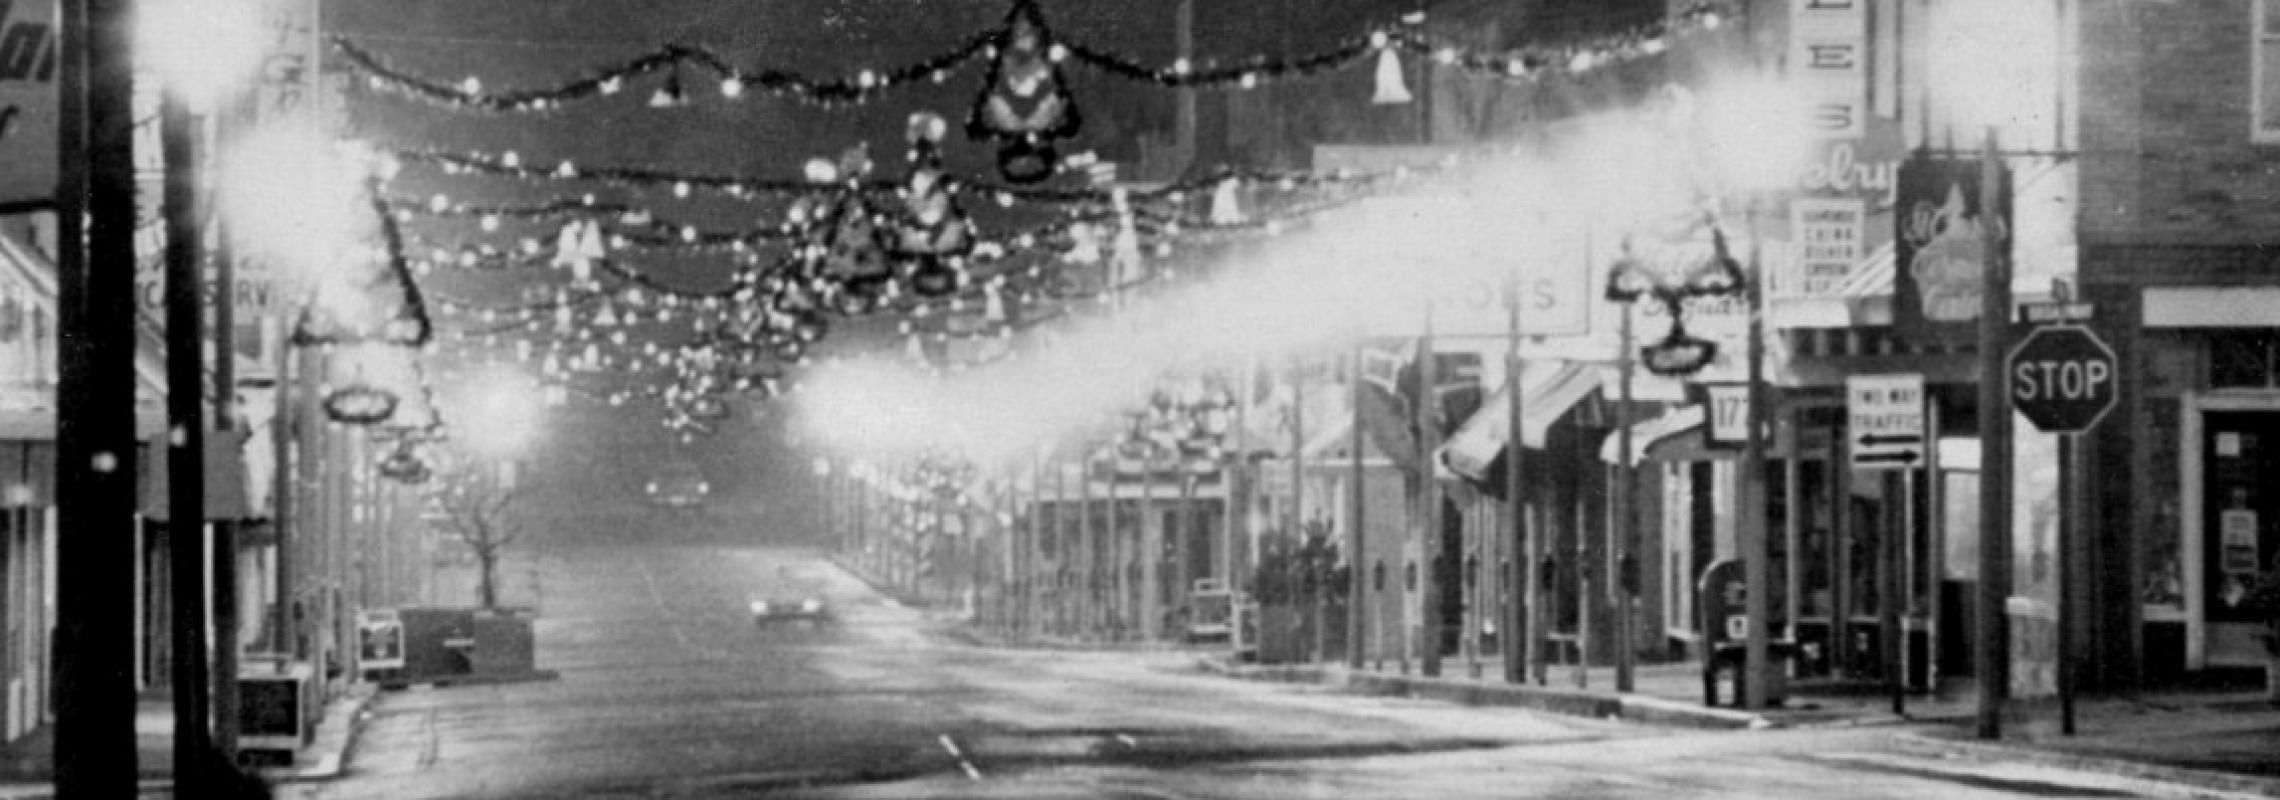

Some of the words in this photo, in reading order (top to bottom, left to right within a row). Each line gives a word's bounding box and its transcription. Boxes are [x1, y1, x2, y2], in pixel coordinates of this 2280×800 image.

[2015, 361, 2108, 399] STOP
[1855, 388, 1884, 404] TWO
[1888, 388, 1919, 404] WAY
[1718, 396, 1748, 428] 17
[1854, 413, 1921, 430] TRAFFIC
